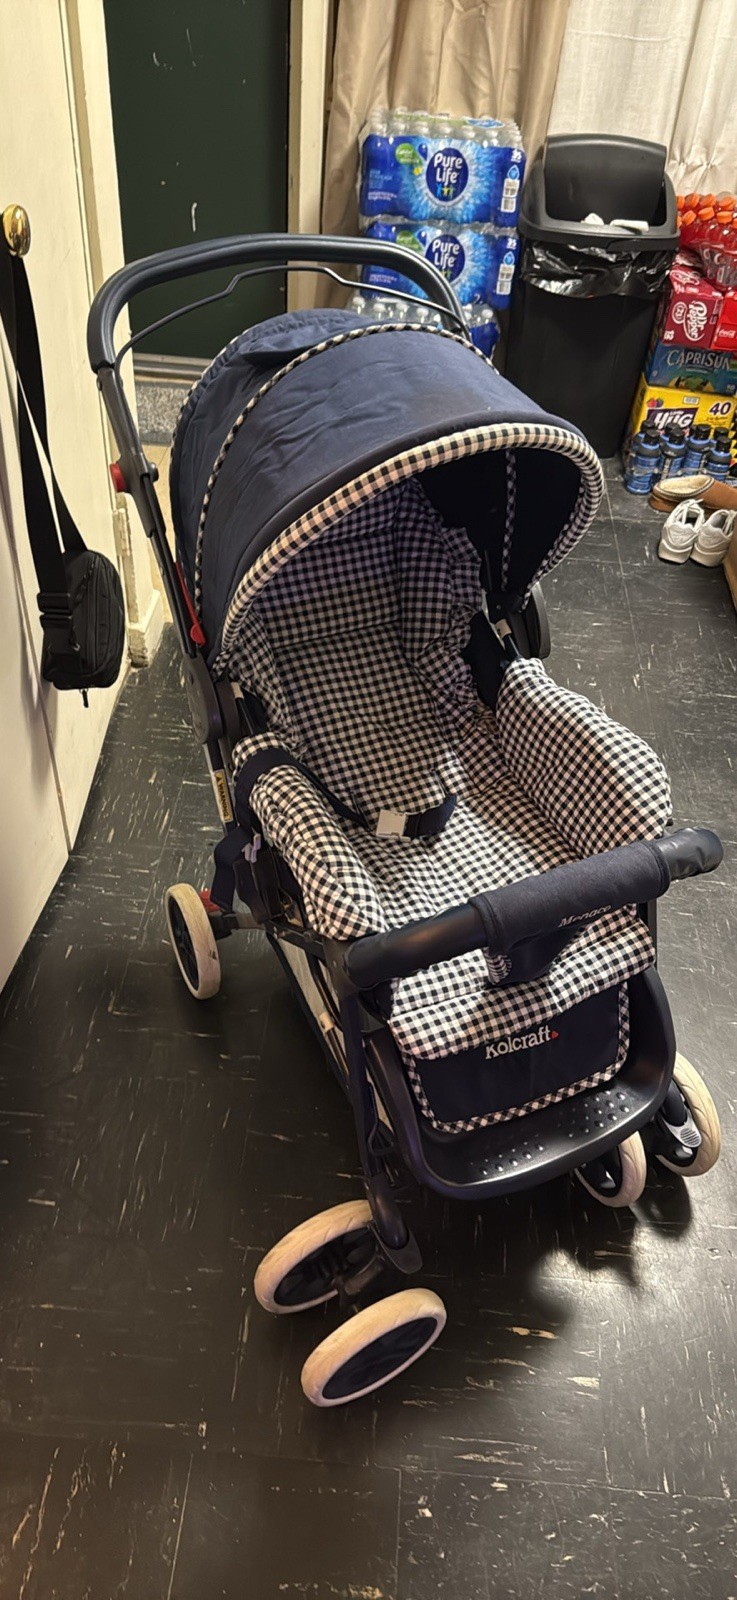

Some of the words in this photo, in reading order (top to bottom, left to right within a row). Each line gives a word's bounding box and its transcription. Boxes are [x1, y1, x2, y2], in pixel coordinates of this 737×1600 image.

[434, 153, 463, 168] Pure
[436, 167, 459, 186] Life
[432, 239, 460, 254] Pure
[434, 253, 456, 269] Life
[687, 301, 707, 338] Pepper
[709, 401, 732, 416] 40
[218, 783, 229, 817] WARNING
[485, 1025, 551, 1060] Kolcraft
